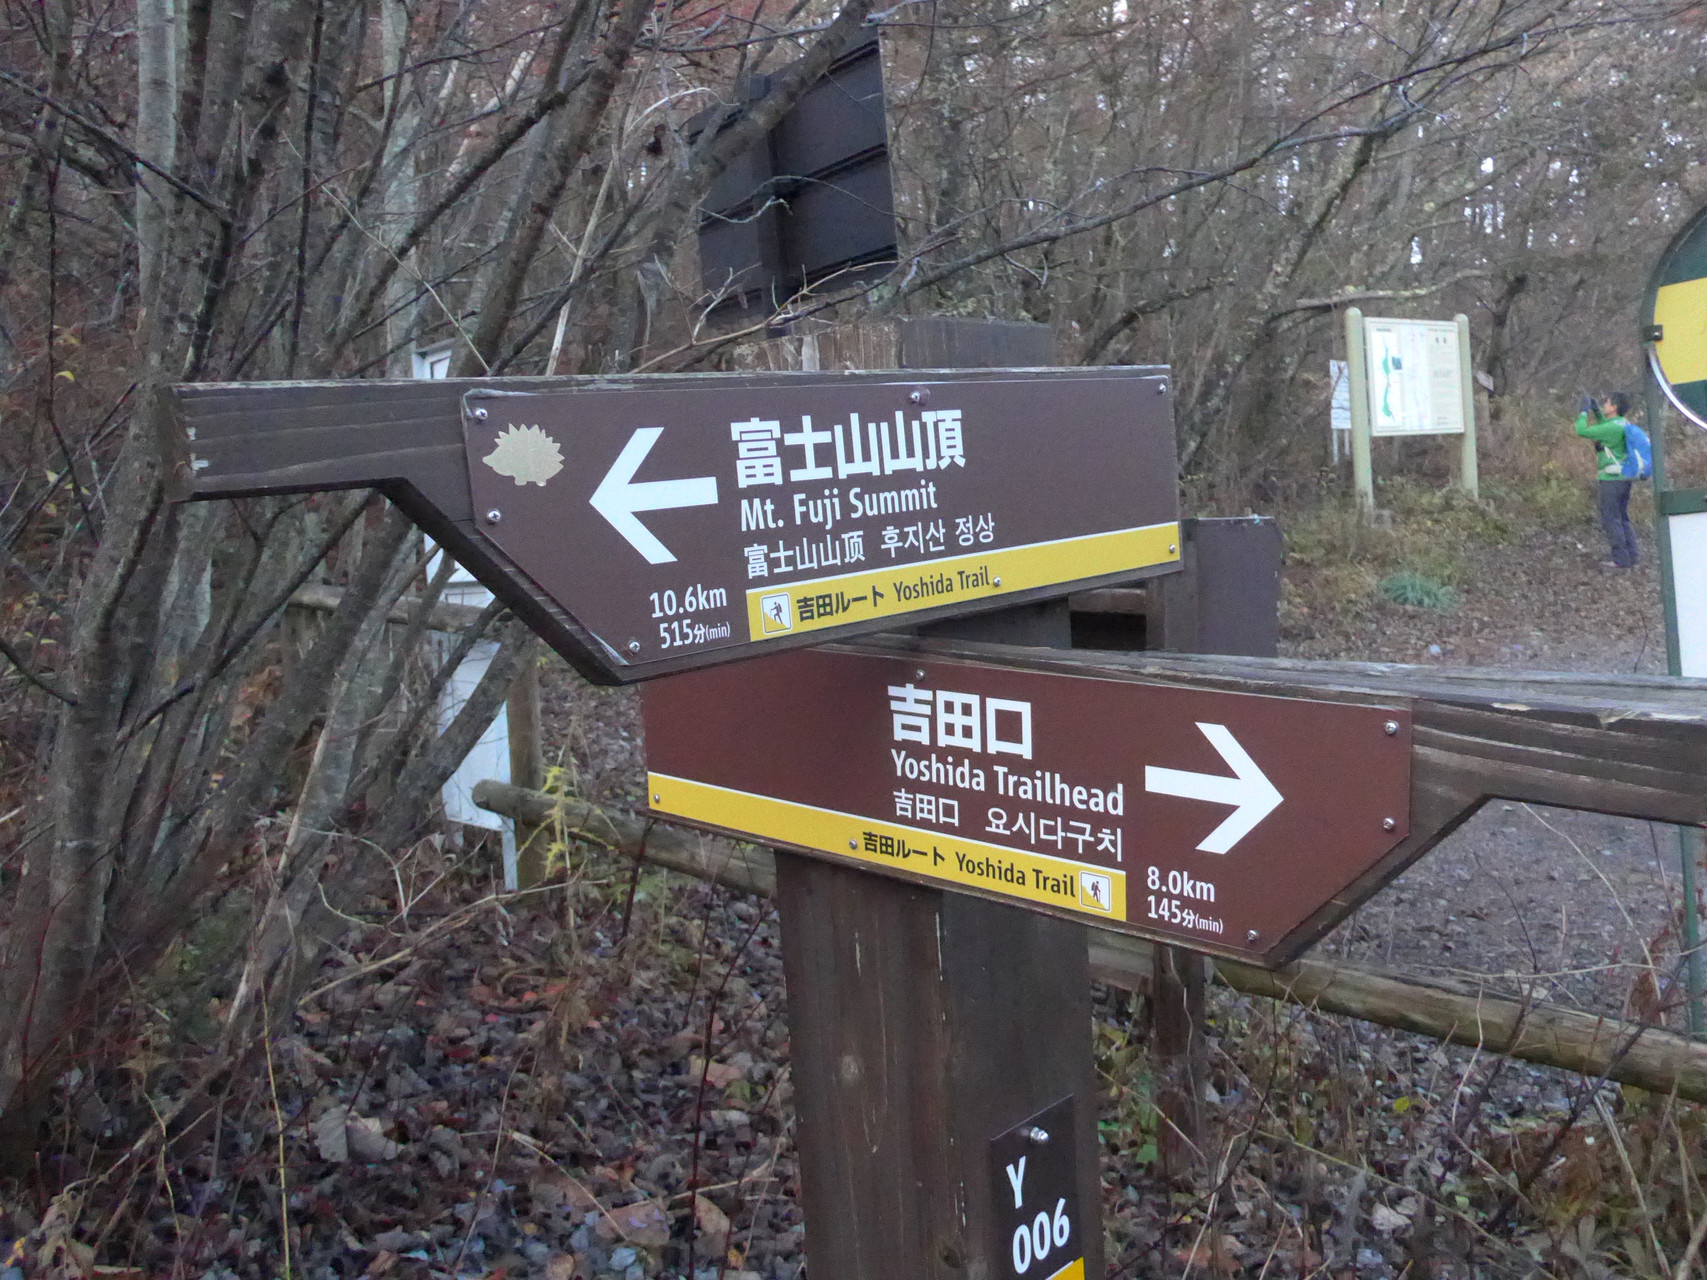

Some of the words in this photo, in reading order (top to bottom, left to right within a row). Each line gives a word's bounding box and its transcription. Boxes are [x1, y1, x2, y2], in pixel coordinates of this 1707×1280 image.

[730, 409, 966, 488] 富士山山頂
[741, 497, 784, 531] Mt.
[793, 488, 841, 530] Fuji
[849, 479, 938, 518] Summit
[744, 530, 866, 579] 富士山山顶
[881, 519, 946, 557] 후지산
[955, 512, 995, 546] 정상
[650, 584, 727, 618] 10.6km
[796, 585, 885, 622] 吉田ルート
[893, 573, 954, 602] Yoshida
[957, 565, 990, 590] Trail
[659, 619, 731, 649] 515分(min)
[888, 683, 1032, 760] 吉田口
[890, 748, 985, 792] Yoshida
[993, 765, 1124, 816] Trailhead
[893, 788, 959, 827] 吉田口
[985, 807, 1122, 862] 요시다구치
[862, 831, 945, 867] 吉田ルート
[955, 851, 1026, 887] Yoshida
[1032, 867, 1076, 897] Trail
[1147, 866, 1215, 903] 8.0km
[1147, 895, 1224, 935] 145分(min)
[1006, 1155, 1026, 1209] Y
[1013, 1197, 1070, 1274] 006
